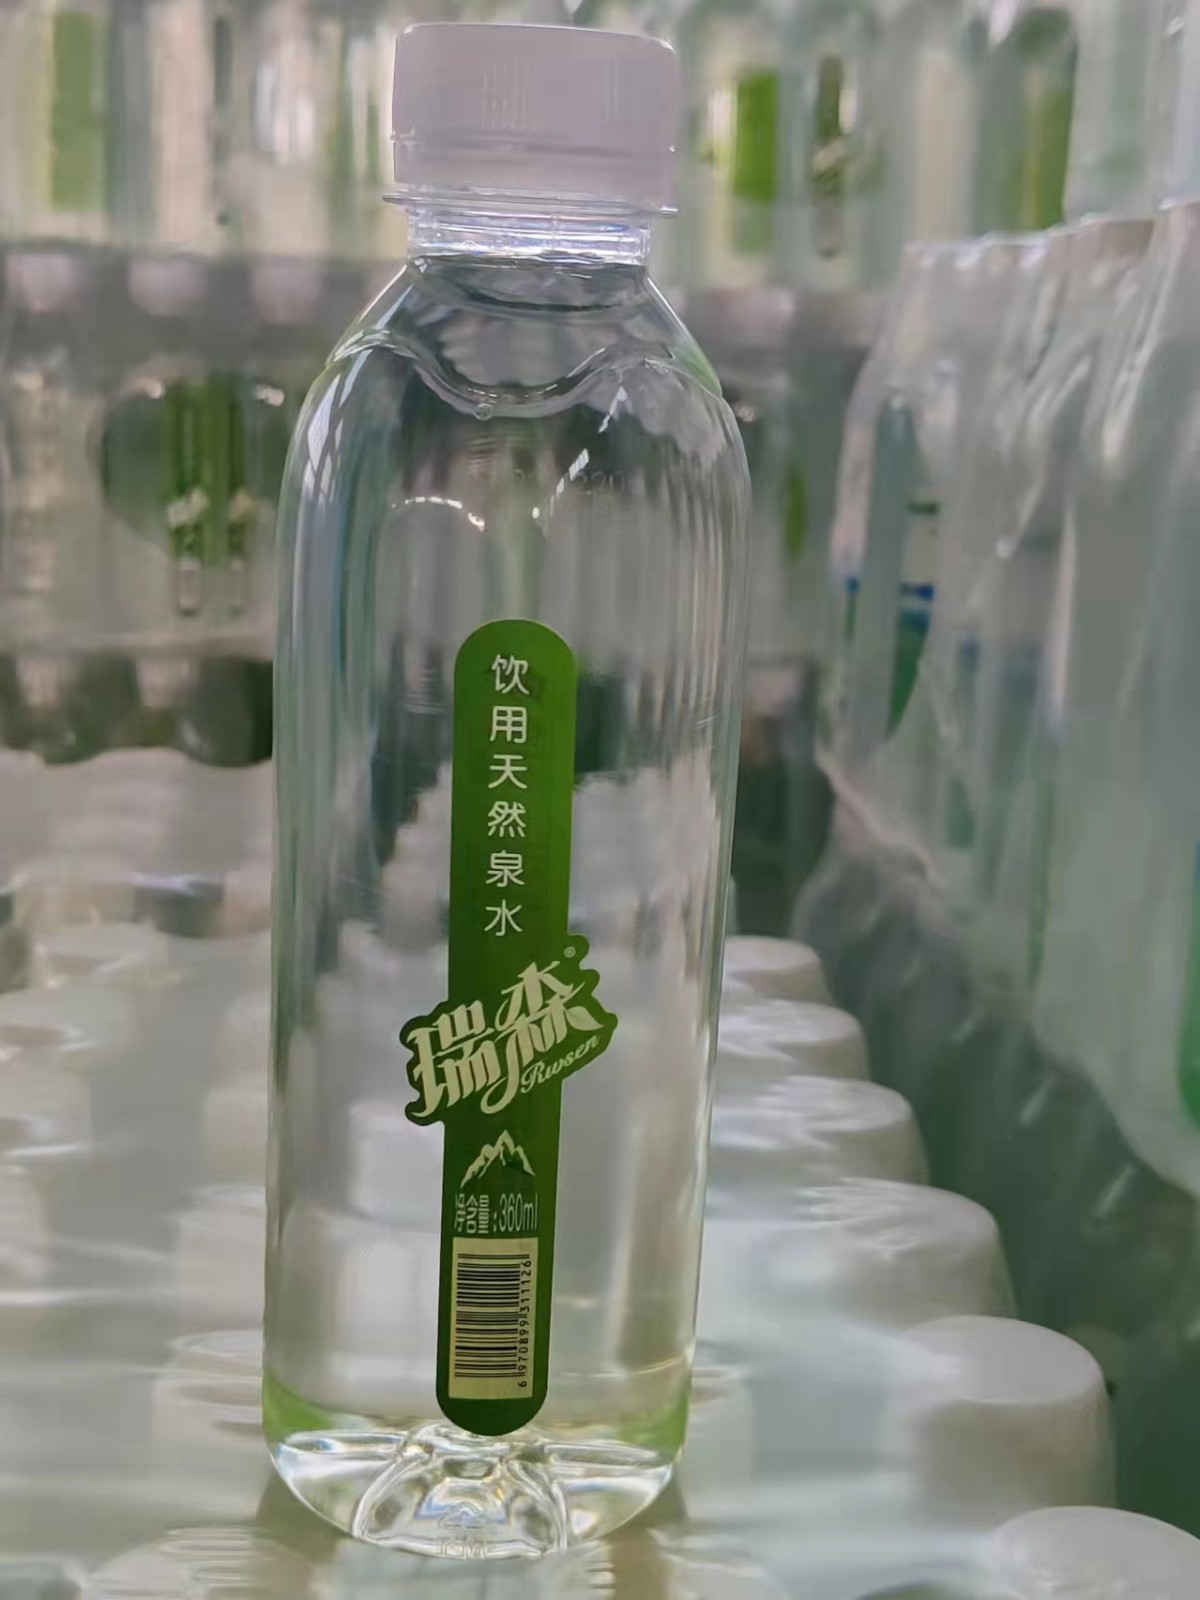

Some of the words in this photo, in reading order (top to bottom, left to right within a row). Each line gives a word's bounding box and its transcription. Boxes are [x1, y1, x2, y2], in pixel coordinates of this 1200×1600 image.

[484, 653, 530, 937] 饮用天然泉水
